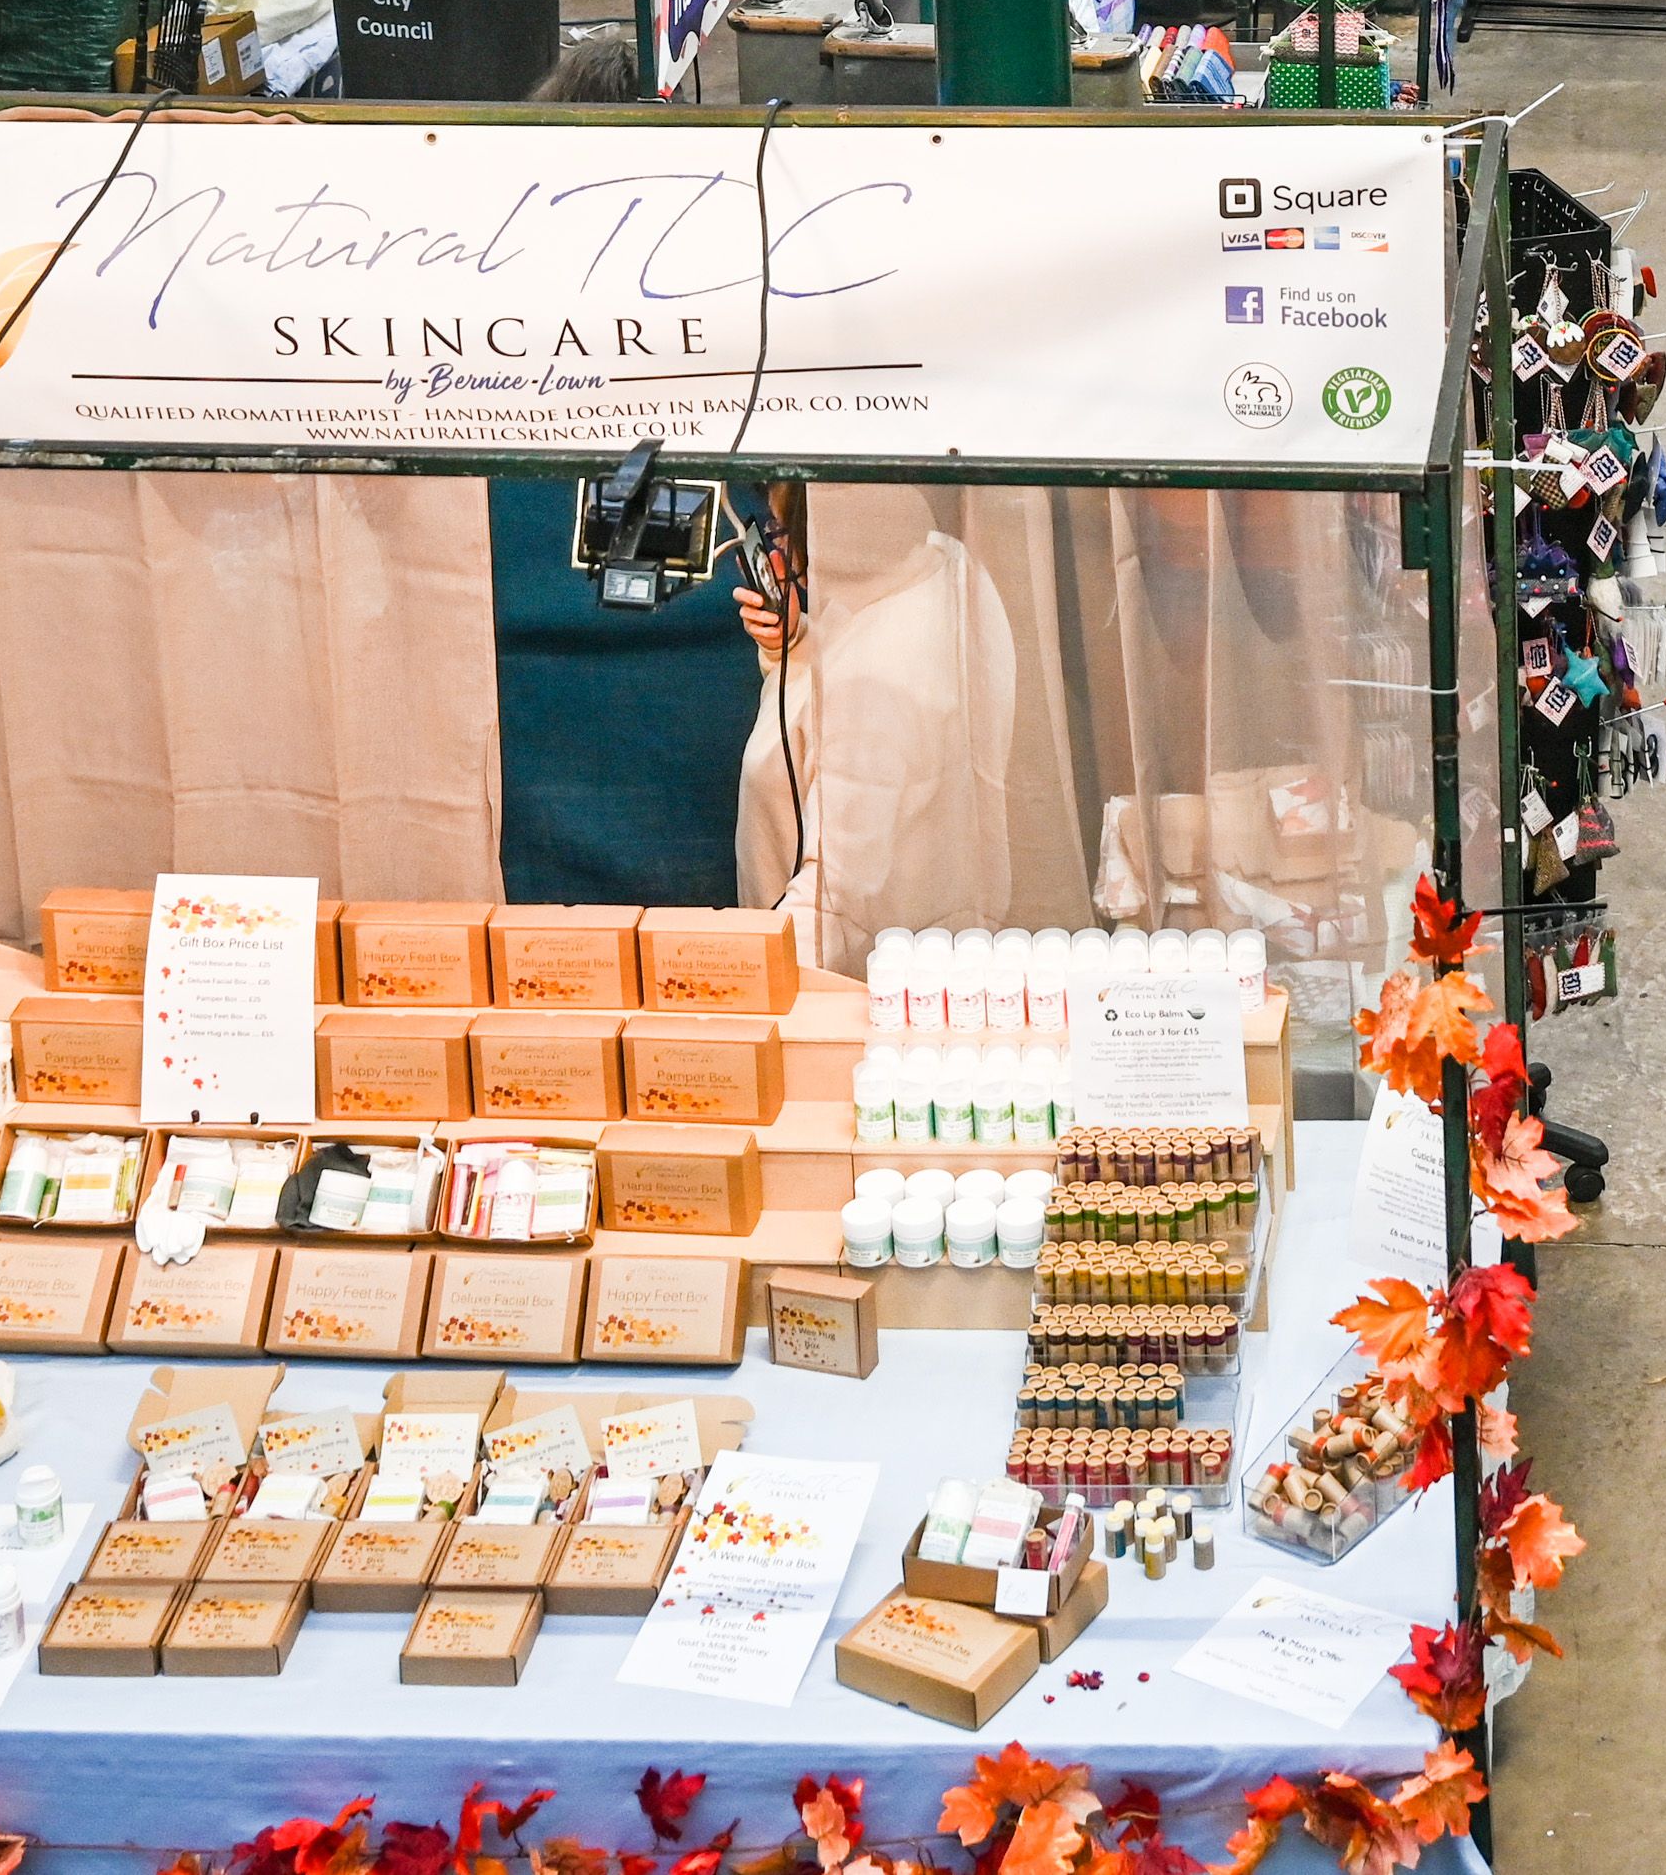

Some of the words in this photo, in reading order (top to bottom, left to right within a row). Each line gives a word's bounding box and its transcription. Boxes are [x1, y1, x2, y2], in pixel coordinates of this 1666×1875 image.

[356, 16, 434, 41] Council
[1273, 185, 1388, 215] Square
[1227, 232, 1261, 244] VISA
[1350, 231, 1387, 240] DISCOVER
[55, 171, 540, 330] Natural
[550, 171, 913, 301] TLC
[1280, 287, 1311, 301] Find
[1317, 291, 1333, 303] us
[1338, 292, 1356, 303] on
[1281, 306, 1388, 329] Facebook
[274, 315, 709, 359] SKINCARE
[385, 369, 417, 404] by
[1325, 368, 1388, 393] VEGETARIAN
[75, 404, 197, 423] QUALIFIED
[200, 404, 404, 423] AROMATHERAPIST
[424, 402, 561, 422] HANDMADE
[564, 401, 663, 420] LOCALLY
[668, 400, 694, 418] IN
[808, 396, 850, 414] CO.
[855, 394, 931, 413] DOWN
[1235, 403, 1251, 411] NOT
[1253, 403, 1282, 412] TESTED
[1249, 410, 1282, 418] ANIMALS
[1332, 409, 1382, 429] FRIENDLY
[305, 420, 705, 444] WWW.NATURALTLCSKINCARE.CO.UK
[76, 941, 125, 957] Pamper
[179, 936, 200, 950] Gift
[203, 937, 225, 950] Box
[229, 937, 260, 950] Price
[262, 939, 284, 951] List
[363, 950, 407, 966] Happy
[409, 951, 437, 963] Feet
[440, 952, 463, 964] Box
[555, 958, 589, 970] Facial
[593, 959, 616, 970] Box
[661, 959, 693, 971] Hand
[696, 960, 738, 972] Rescue
[740, 961, 763, 972] Box
[1125, 1010, 1141, 1018] Eco
[1143, 1010, 1156, 1020] Lip
[1159, 1010, 1184, 1019] Balms
[1112, 1028, 1123, 1037] £6
[1125, 1028, 1145, 1037] each
[1159, 1028, 1165, 1036] 3
[1167, 1028, 1180, 1036] for
[1183, 1027, 1199, 1036] £15
[44, 1052, 95, 1067] Pamper
[96, 1054, 122, 1066] Box
[339, 1065, 383, 1080] Happy
[386, 1066, 414, 1079] Feet
[416, 1068, 440, 1080] Box
[657, 1070, 706, 1086] Pamper
[709, 1072, 733, 1085] Box
[295, 1283, 341, 1302] Happy
[343, 1284, 372, 1299] Feet
[374, 1286, 398, 1301] Box
[607, 1288, 652, 1304] Happy
[654, 1290, 683, 1302] Feet
[685, 1292, 710, 1304] Box
